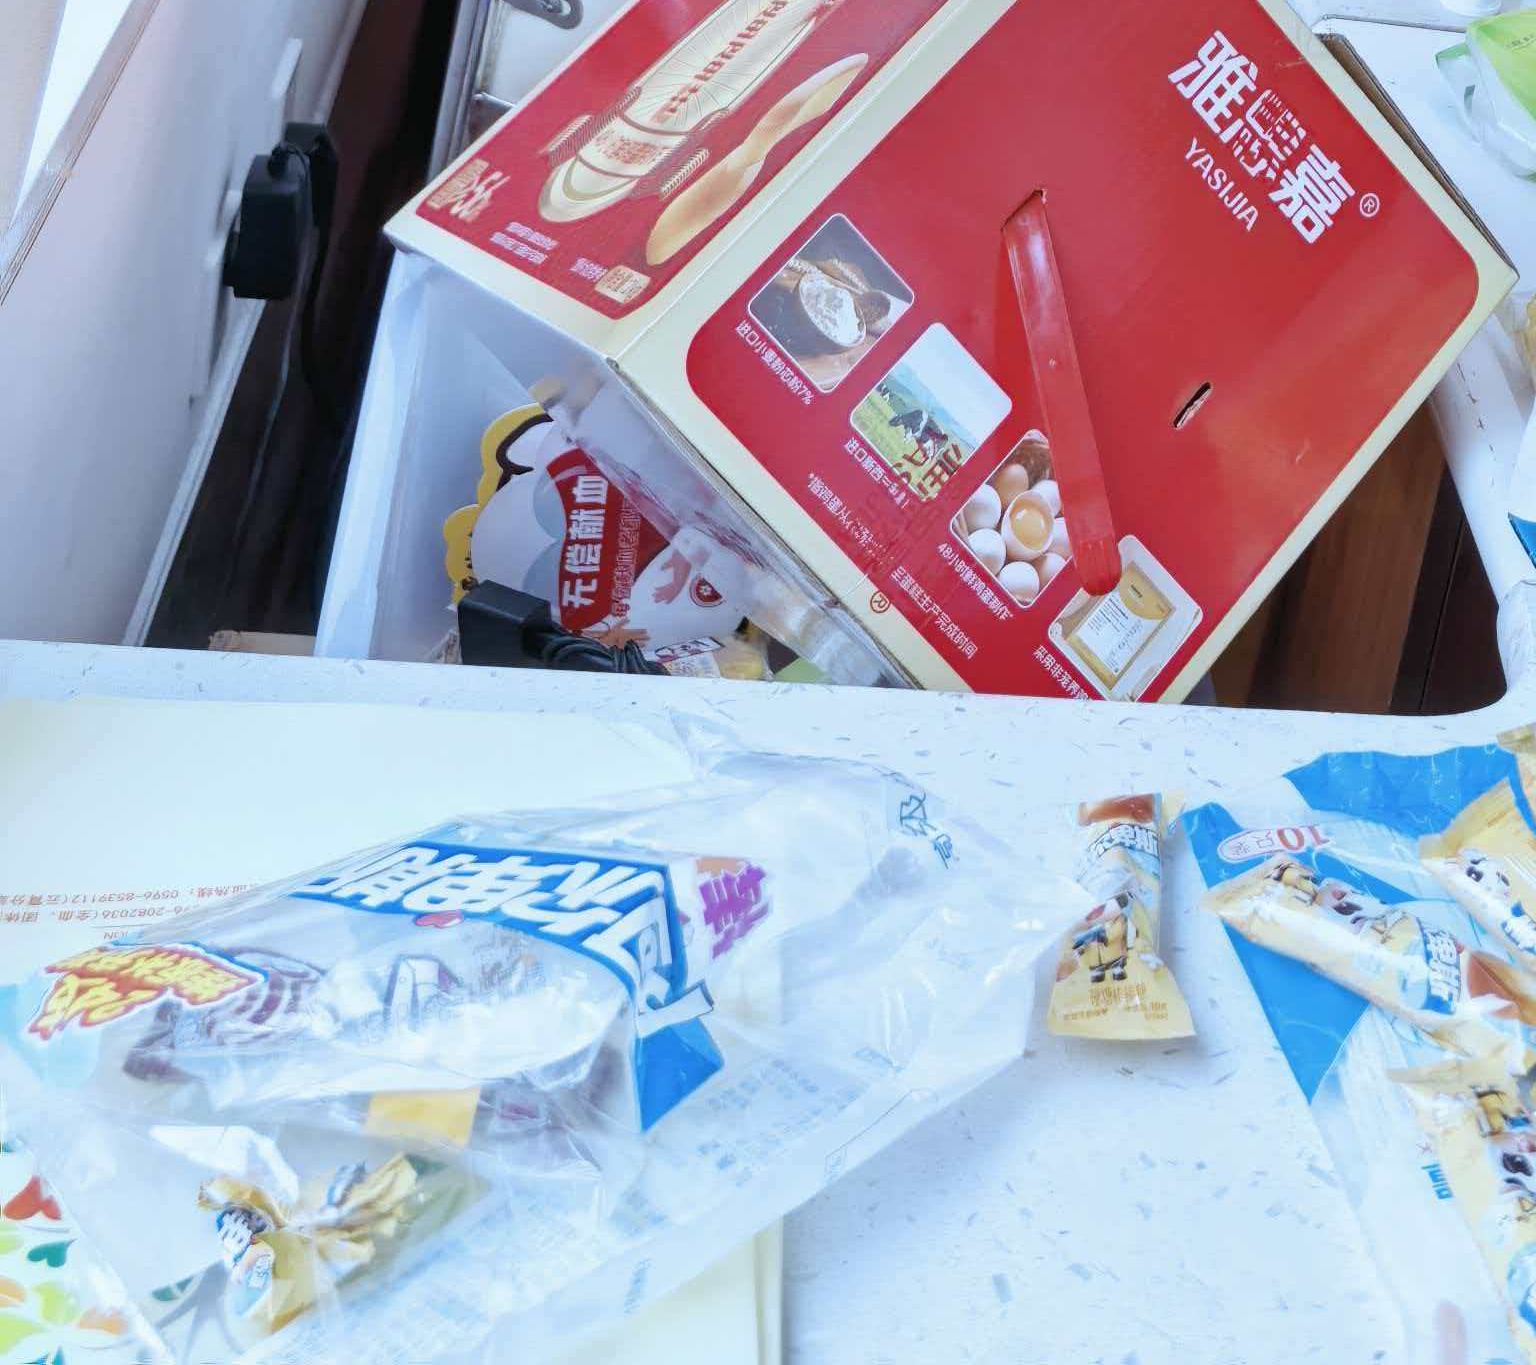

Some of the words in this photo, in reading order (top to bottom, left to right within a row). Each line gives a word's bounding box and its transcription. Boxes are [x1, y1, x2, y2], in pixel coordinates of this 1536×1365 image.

[1167, 30, 1356, 245] 雅思嘉
[1183, 137, 1260, 232] YASIJIA
[562, 475, 609, 608] 无偿献血
